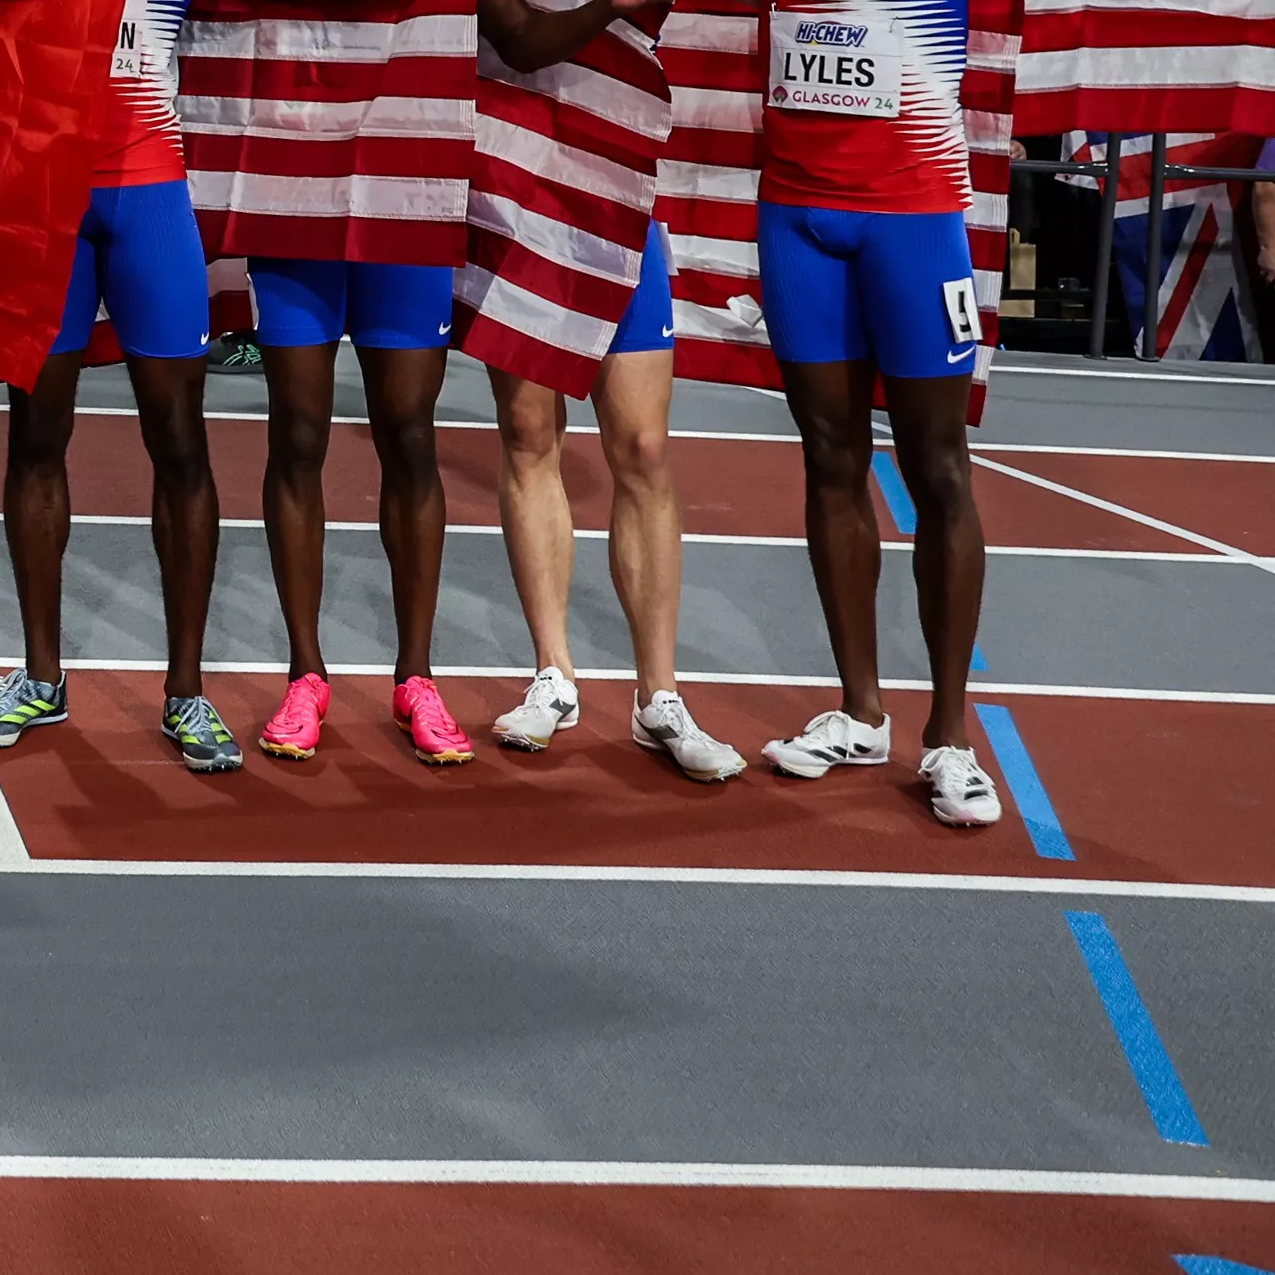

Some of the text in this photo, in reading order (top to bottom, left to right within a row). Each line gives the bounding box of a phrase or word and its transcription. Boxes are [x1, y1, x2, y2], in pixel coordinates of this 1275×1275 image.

[796, 21, 868, 47] HI-CHEW
[115, 58, 133, 71] 24
[784, 52, 875, 87] LYLES
[792, 91, 893, 110] GLASGOW 24
